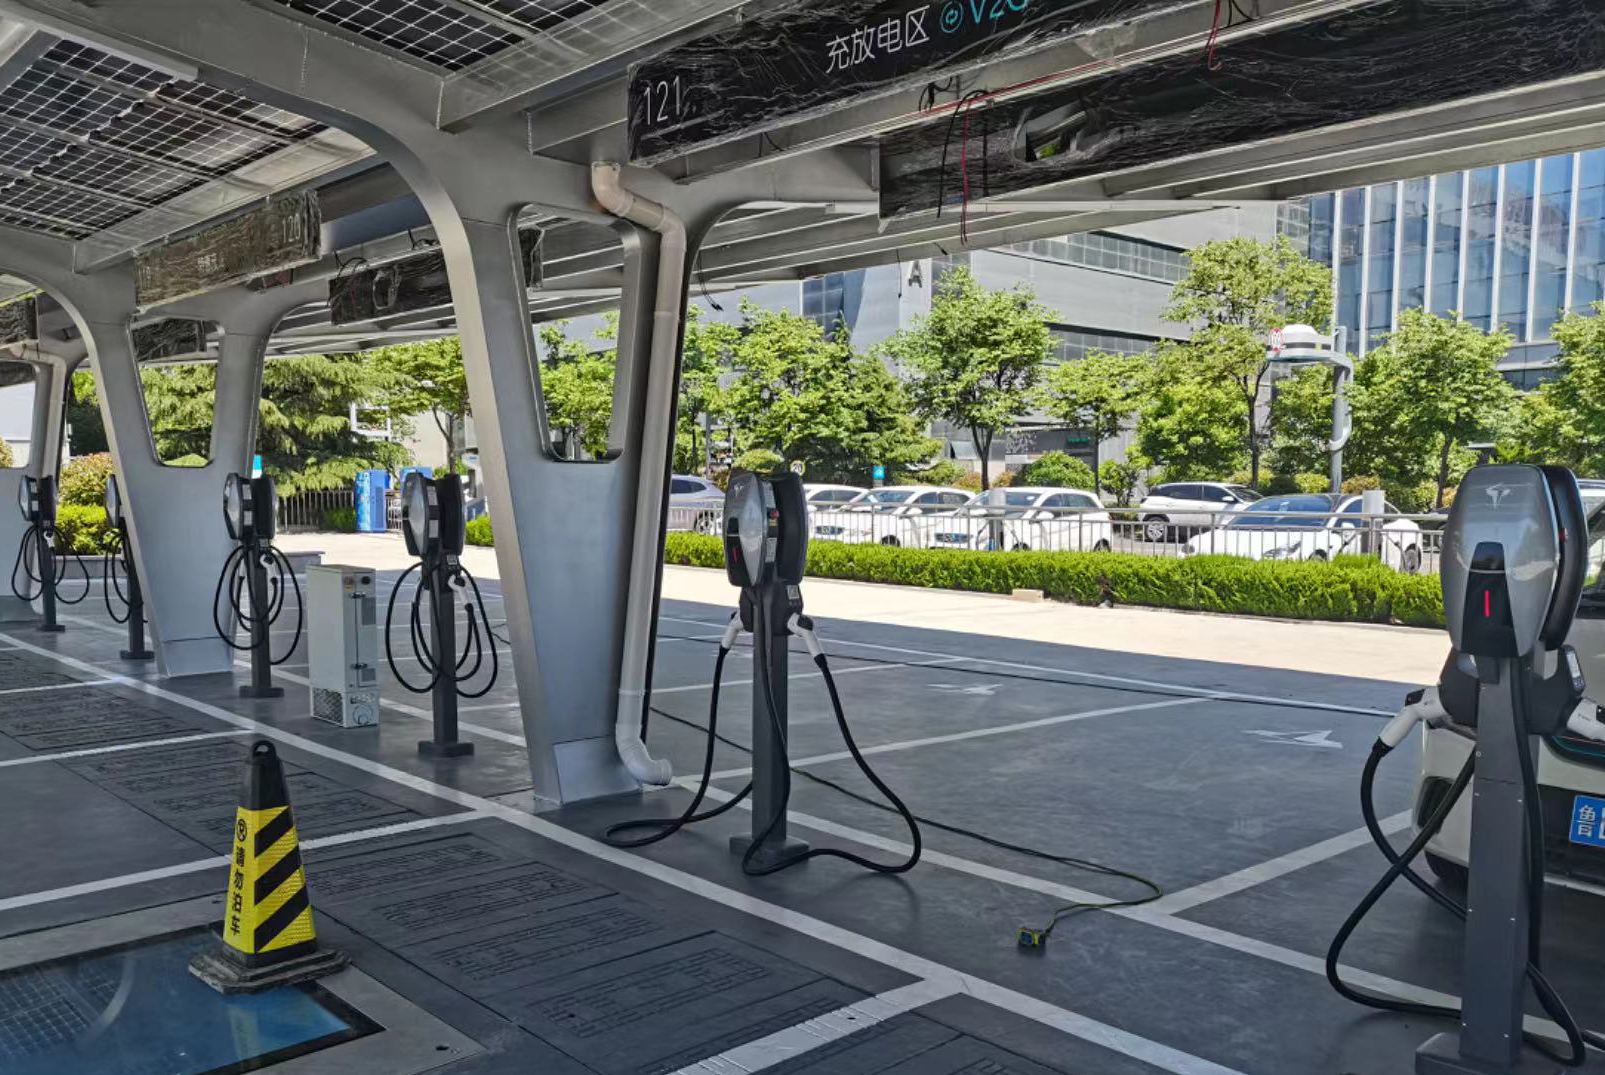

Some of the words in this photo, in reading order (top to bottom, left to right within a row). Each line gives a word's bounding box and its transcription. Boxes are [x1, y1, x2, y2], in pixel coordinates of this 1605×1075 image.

[825, 5, 931, 74] 充放电区
[643, 74, 681, 126] 121
[1577, 804, 1605, 840] 鲁
